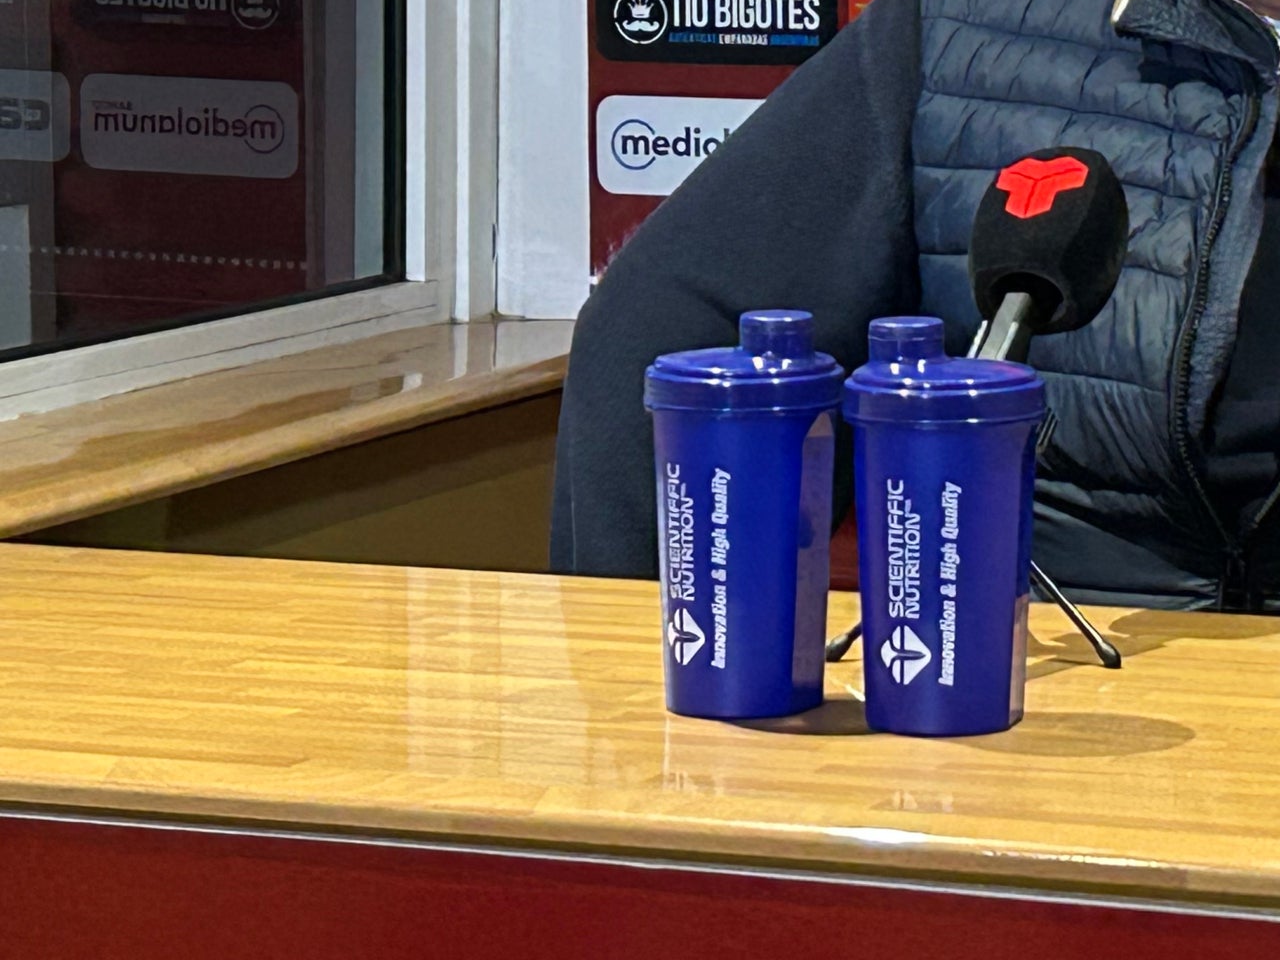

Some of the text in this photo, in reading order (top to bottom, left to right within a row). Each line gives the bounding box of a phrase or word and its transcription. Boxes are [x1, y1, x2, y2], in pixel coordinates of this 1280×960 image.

[680, 483, 694, 600] NUTRITION
[711, 468, 730, 668] Innovation & High Quality
[887, 479, 904, 618] SCIENTIFFIC
[905, 499, 920, 619] NUTRITION
[939, 482, 962, 686] Innovation & High Quality
